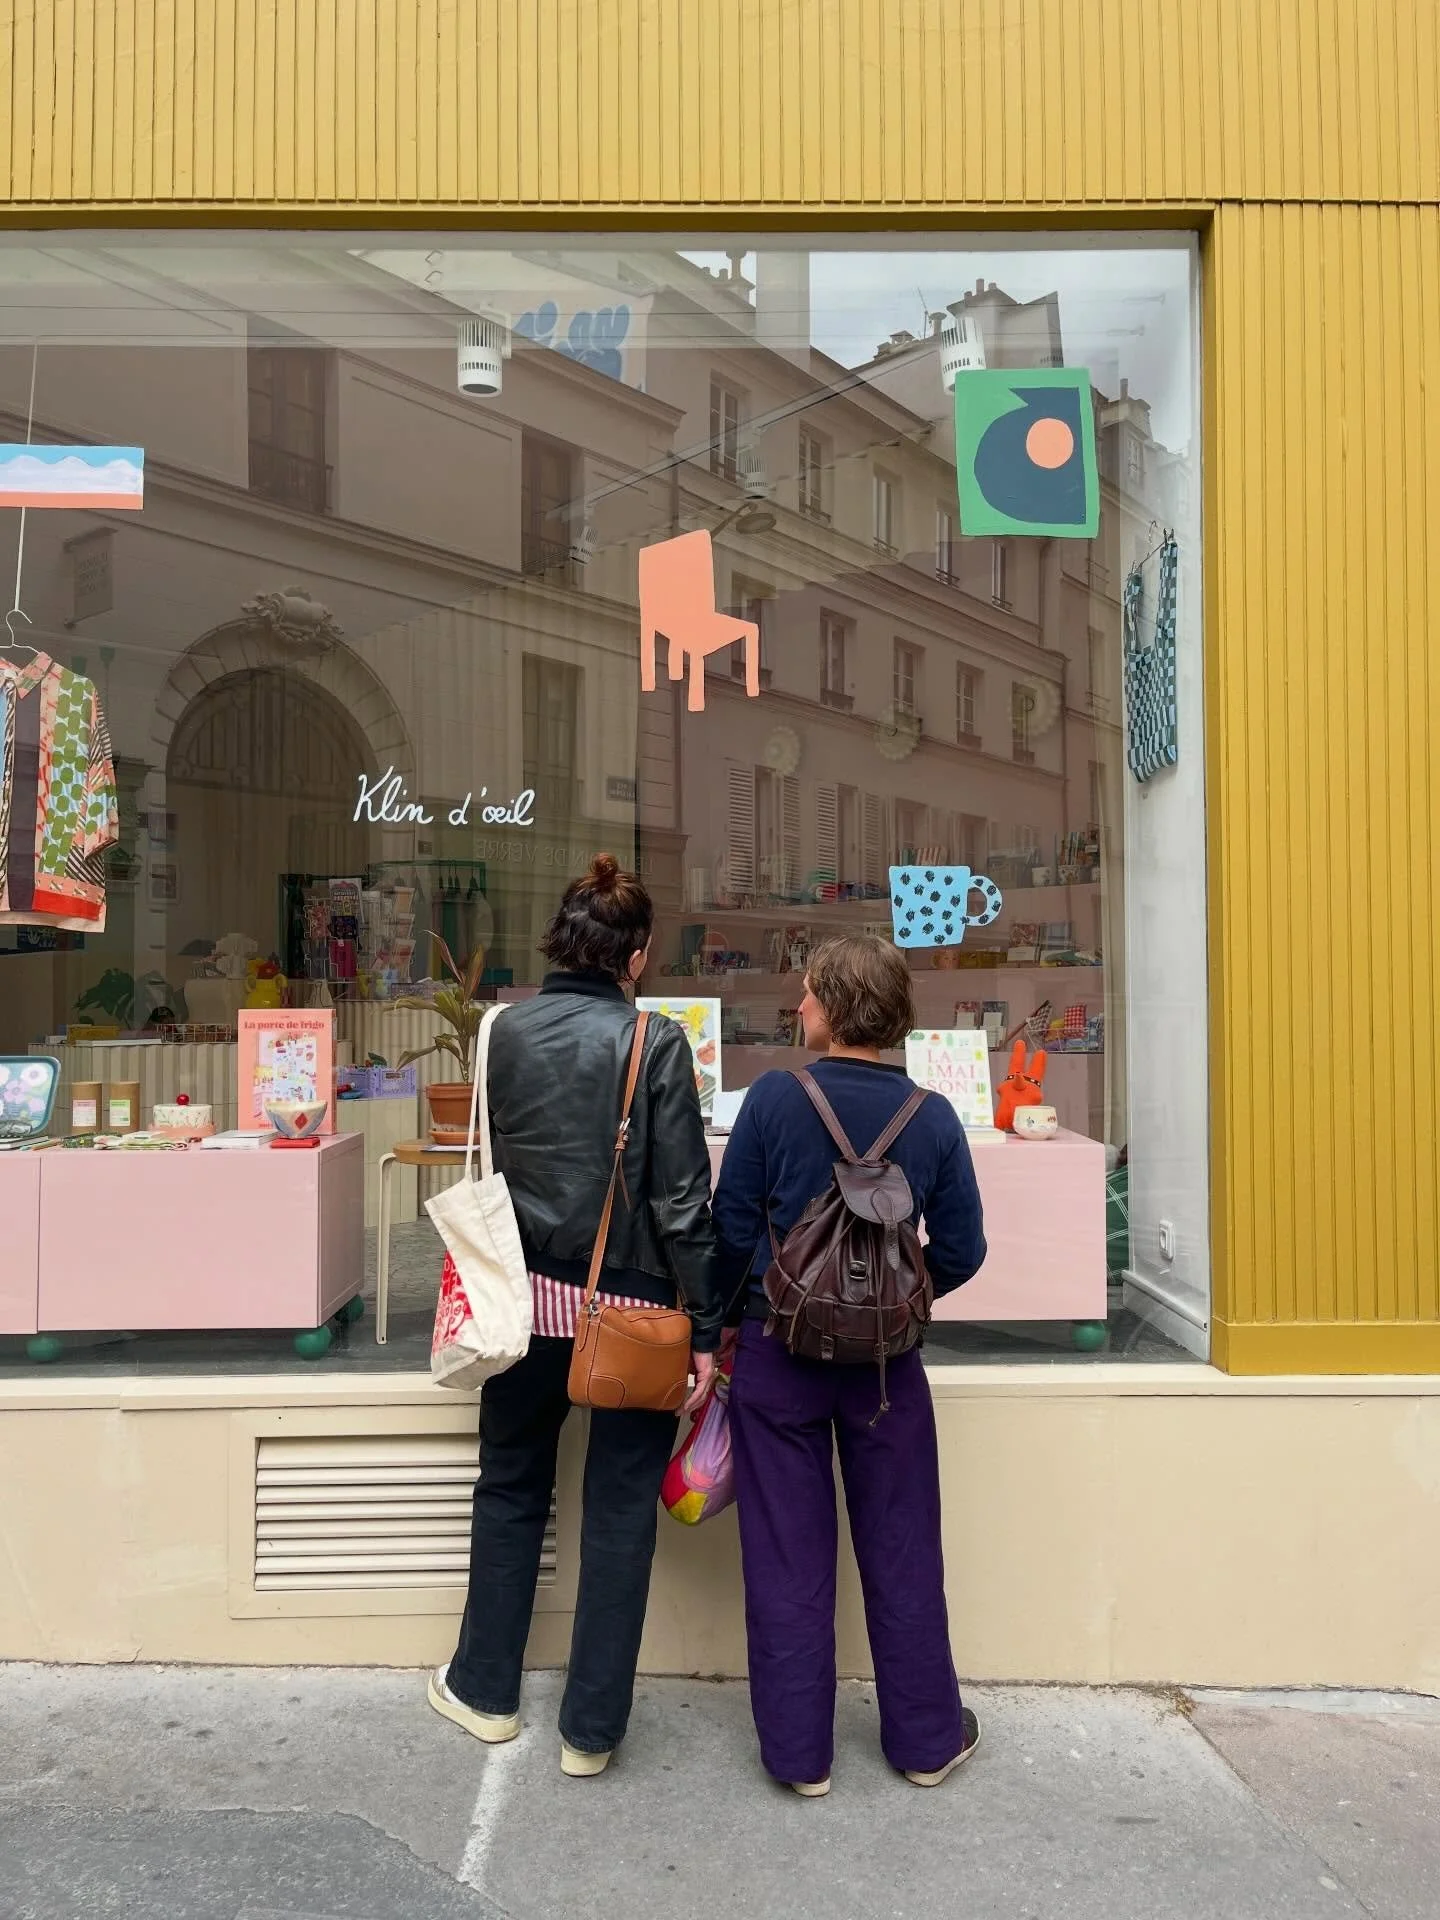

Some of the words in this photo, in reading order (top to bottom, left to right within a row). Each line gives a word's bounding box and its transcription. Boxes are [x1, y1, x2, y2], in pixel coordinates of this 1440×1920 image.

[353, 765, 434, 825] Klin
[244, 1021, 255, 1029] La
[258, 1021, 284, 1030] porte
[287, 1020, 299, 1029] de
[300, 1020, 325, 1030] frigo
[928, 1049, 952, 1063] LA
[936, 1064, 976, 1078] MAI
[927, 1080, 968, 1093] SON
